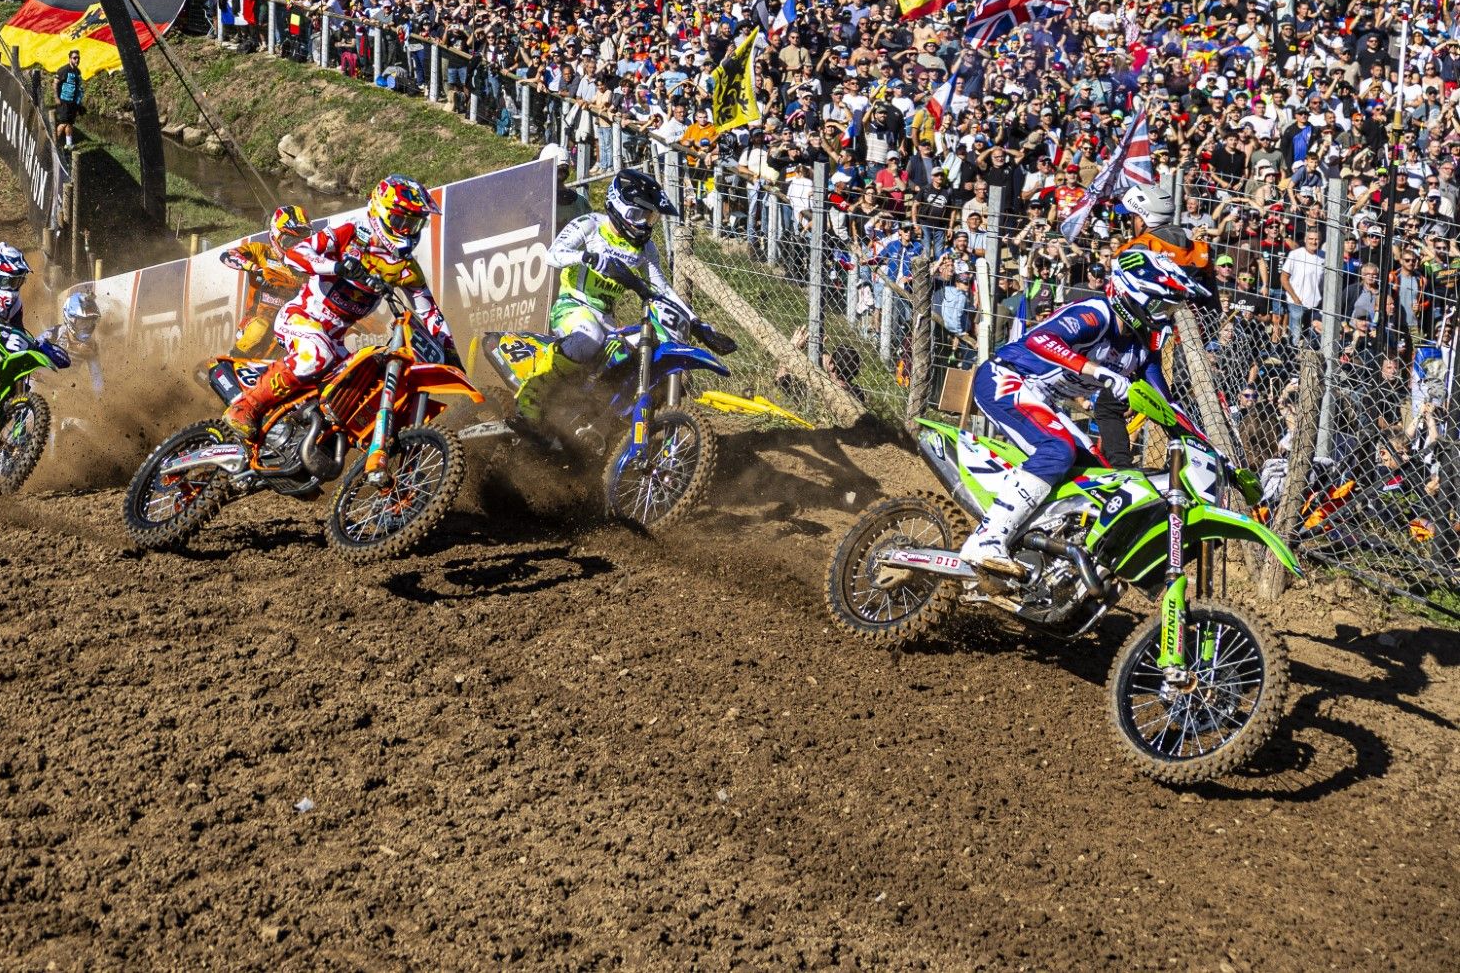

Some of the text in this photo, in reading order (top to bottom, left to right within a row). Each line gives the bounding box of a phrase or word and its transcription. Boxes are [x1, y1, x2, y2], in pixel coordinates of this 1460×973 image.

[1, 100, 18, 148] FOX
[31, 156, 48, 210] FOX
[455, 242, 549, 308] MOTO
[594, 277, 625, 296] YAMAH
[499, 340, 531, 364] 34
[1046, 338, 1078, 361] SHOT
[1170, 527, 1181, 567] SHOWA
[1167, 599, 1176, 656] DUNLOP
